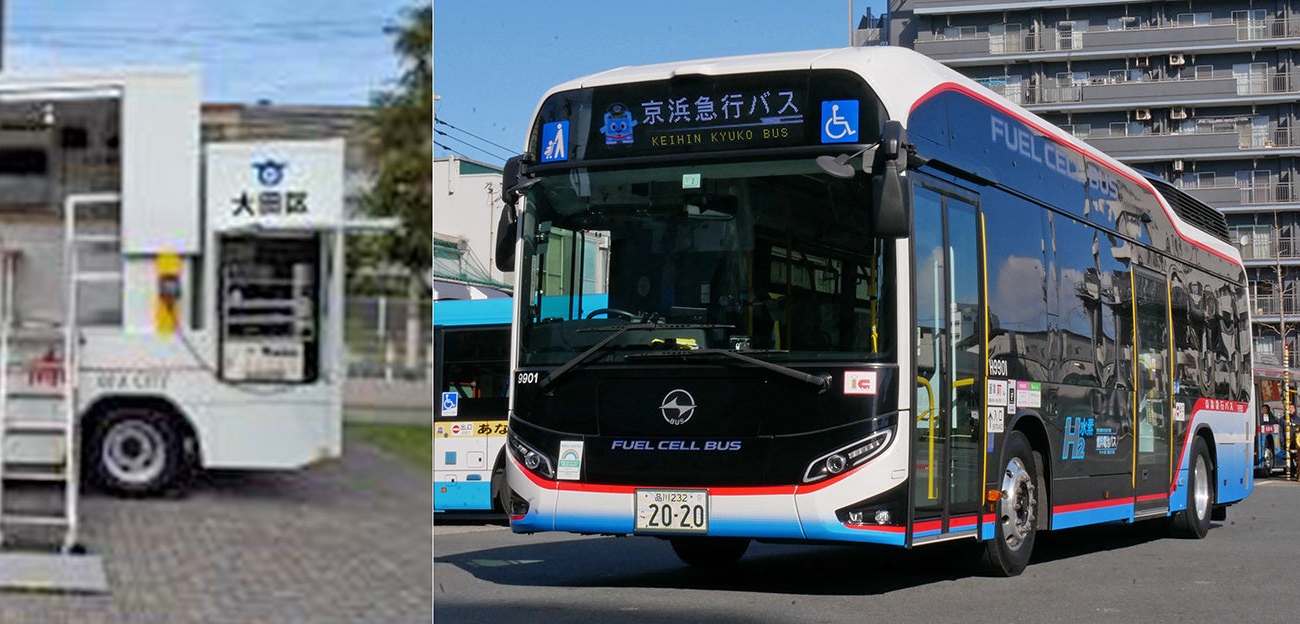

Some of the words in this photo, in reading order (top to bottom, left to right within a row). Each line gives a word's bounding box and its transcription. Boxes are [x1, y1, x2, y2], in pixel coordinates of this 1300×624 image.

[641, 91, 800, 125] 京浜急行バス
[651, 134, 701, 147] KEIHIN
[711, 130, 753, 143] KYUKO
[763, 128, 789, 139] BUS
[990, 114, 1042, 164] FUEL
[1044, 143, 1087, 184] CELL
[1087, 161, 1119, 200] BUS
[231, 190, 308, 217] 大田区
[517, 372, 539, 384] 9901
[669, 418, 685, 426] BUS
[1080, 417, 1095, 436] 水素
[611, 440, 655, 450] FUEL
[657, 440, 701, 451] CELL
[704, 440, 742, 451] BUS
[655, 493, 688, 502] 品川232
[649, 504, 704, 527] 20-20
